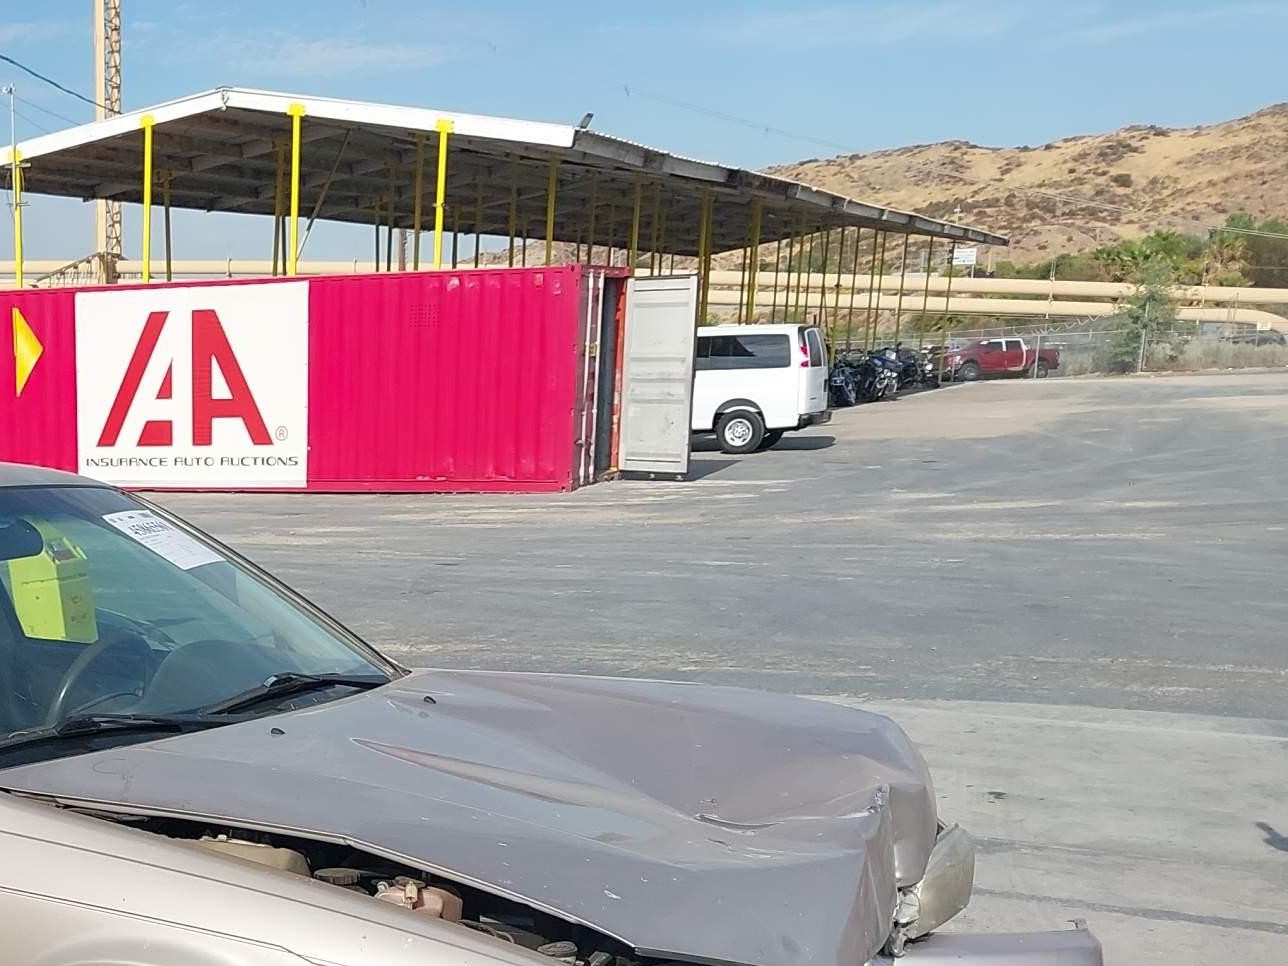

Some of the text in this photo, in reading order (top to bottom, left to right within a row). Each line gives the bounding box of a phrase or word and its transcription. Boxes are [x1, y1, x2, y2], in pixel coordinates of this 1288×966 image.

[86, 456, 299, 467] INSURANCE AUTO AUCTIONS
